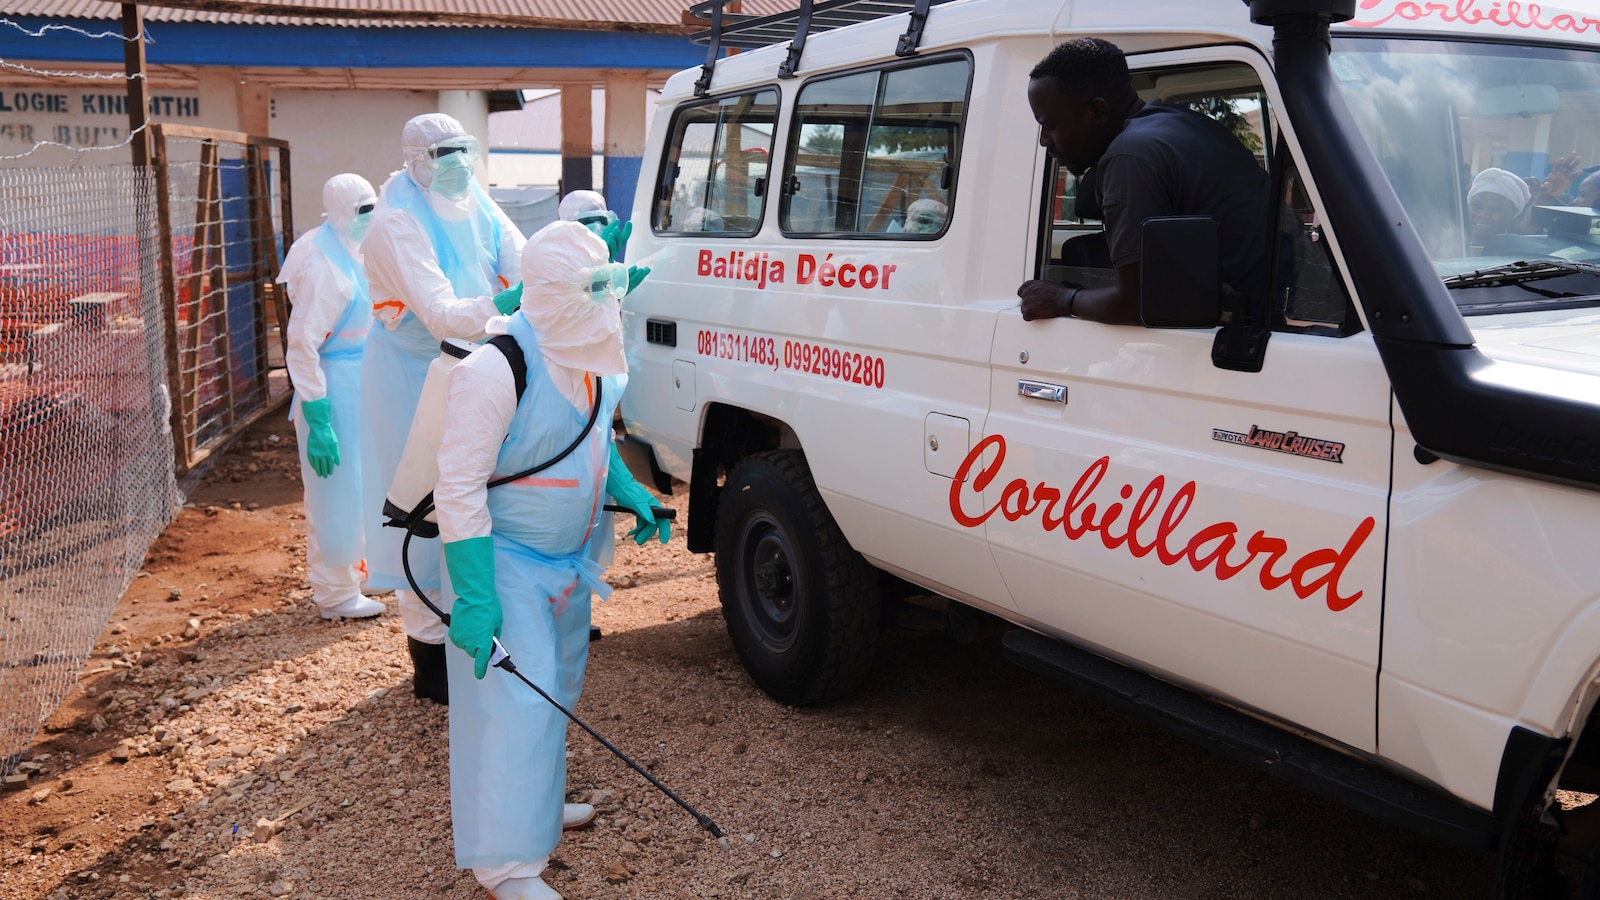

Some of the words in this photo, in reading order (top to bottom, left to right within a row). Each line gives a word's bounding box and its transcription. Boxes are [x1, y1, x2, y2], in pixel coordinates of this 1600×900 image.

[0, 91, 68, 113] LOGIE
[697, 248, 786, 290] Balidja
[795, 252, 897, 290] Décor
[697, 329, 780, 372] 0815311483,
[783, 339, 886, 389] 0992996280
[1212, 430, 1245, 445] TOYOTA
[949, 433, 1376, 613] Corbillard
